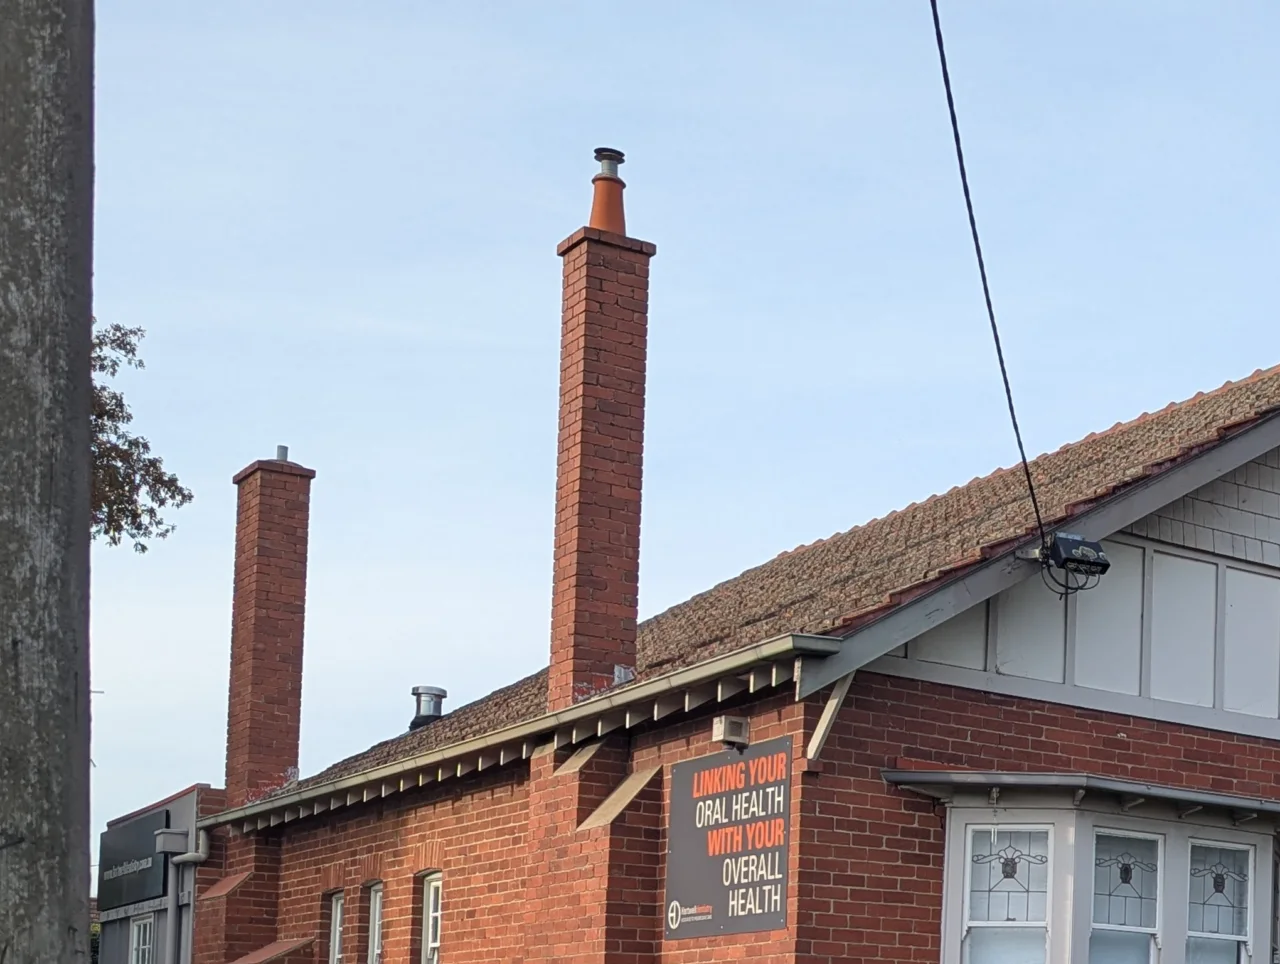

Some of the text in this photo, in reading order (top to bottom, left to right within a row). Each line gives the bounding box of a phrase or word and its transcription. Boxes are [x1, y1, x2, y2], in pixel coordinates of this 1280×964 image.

[693, 752, 787, 798] LINKING YOUR
[695, 785, 785, 828] ORAL HEALTH
[707, 818, 785, 857] WITH YOUR
[722, 851, 783, 886] OVERALL
[728, 884, 781, 917] HEALTH
